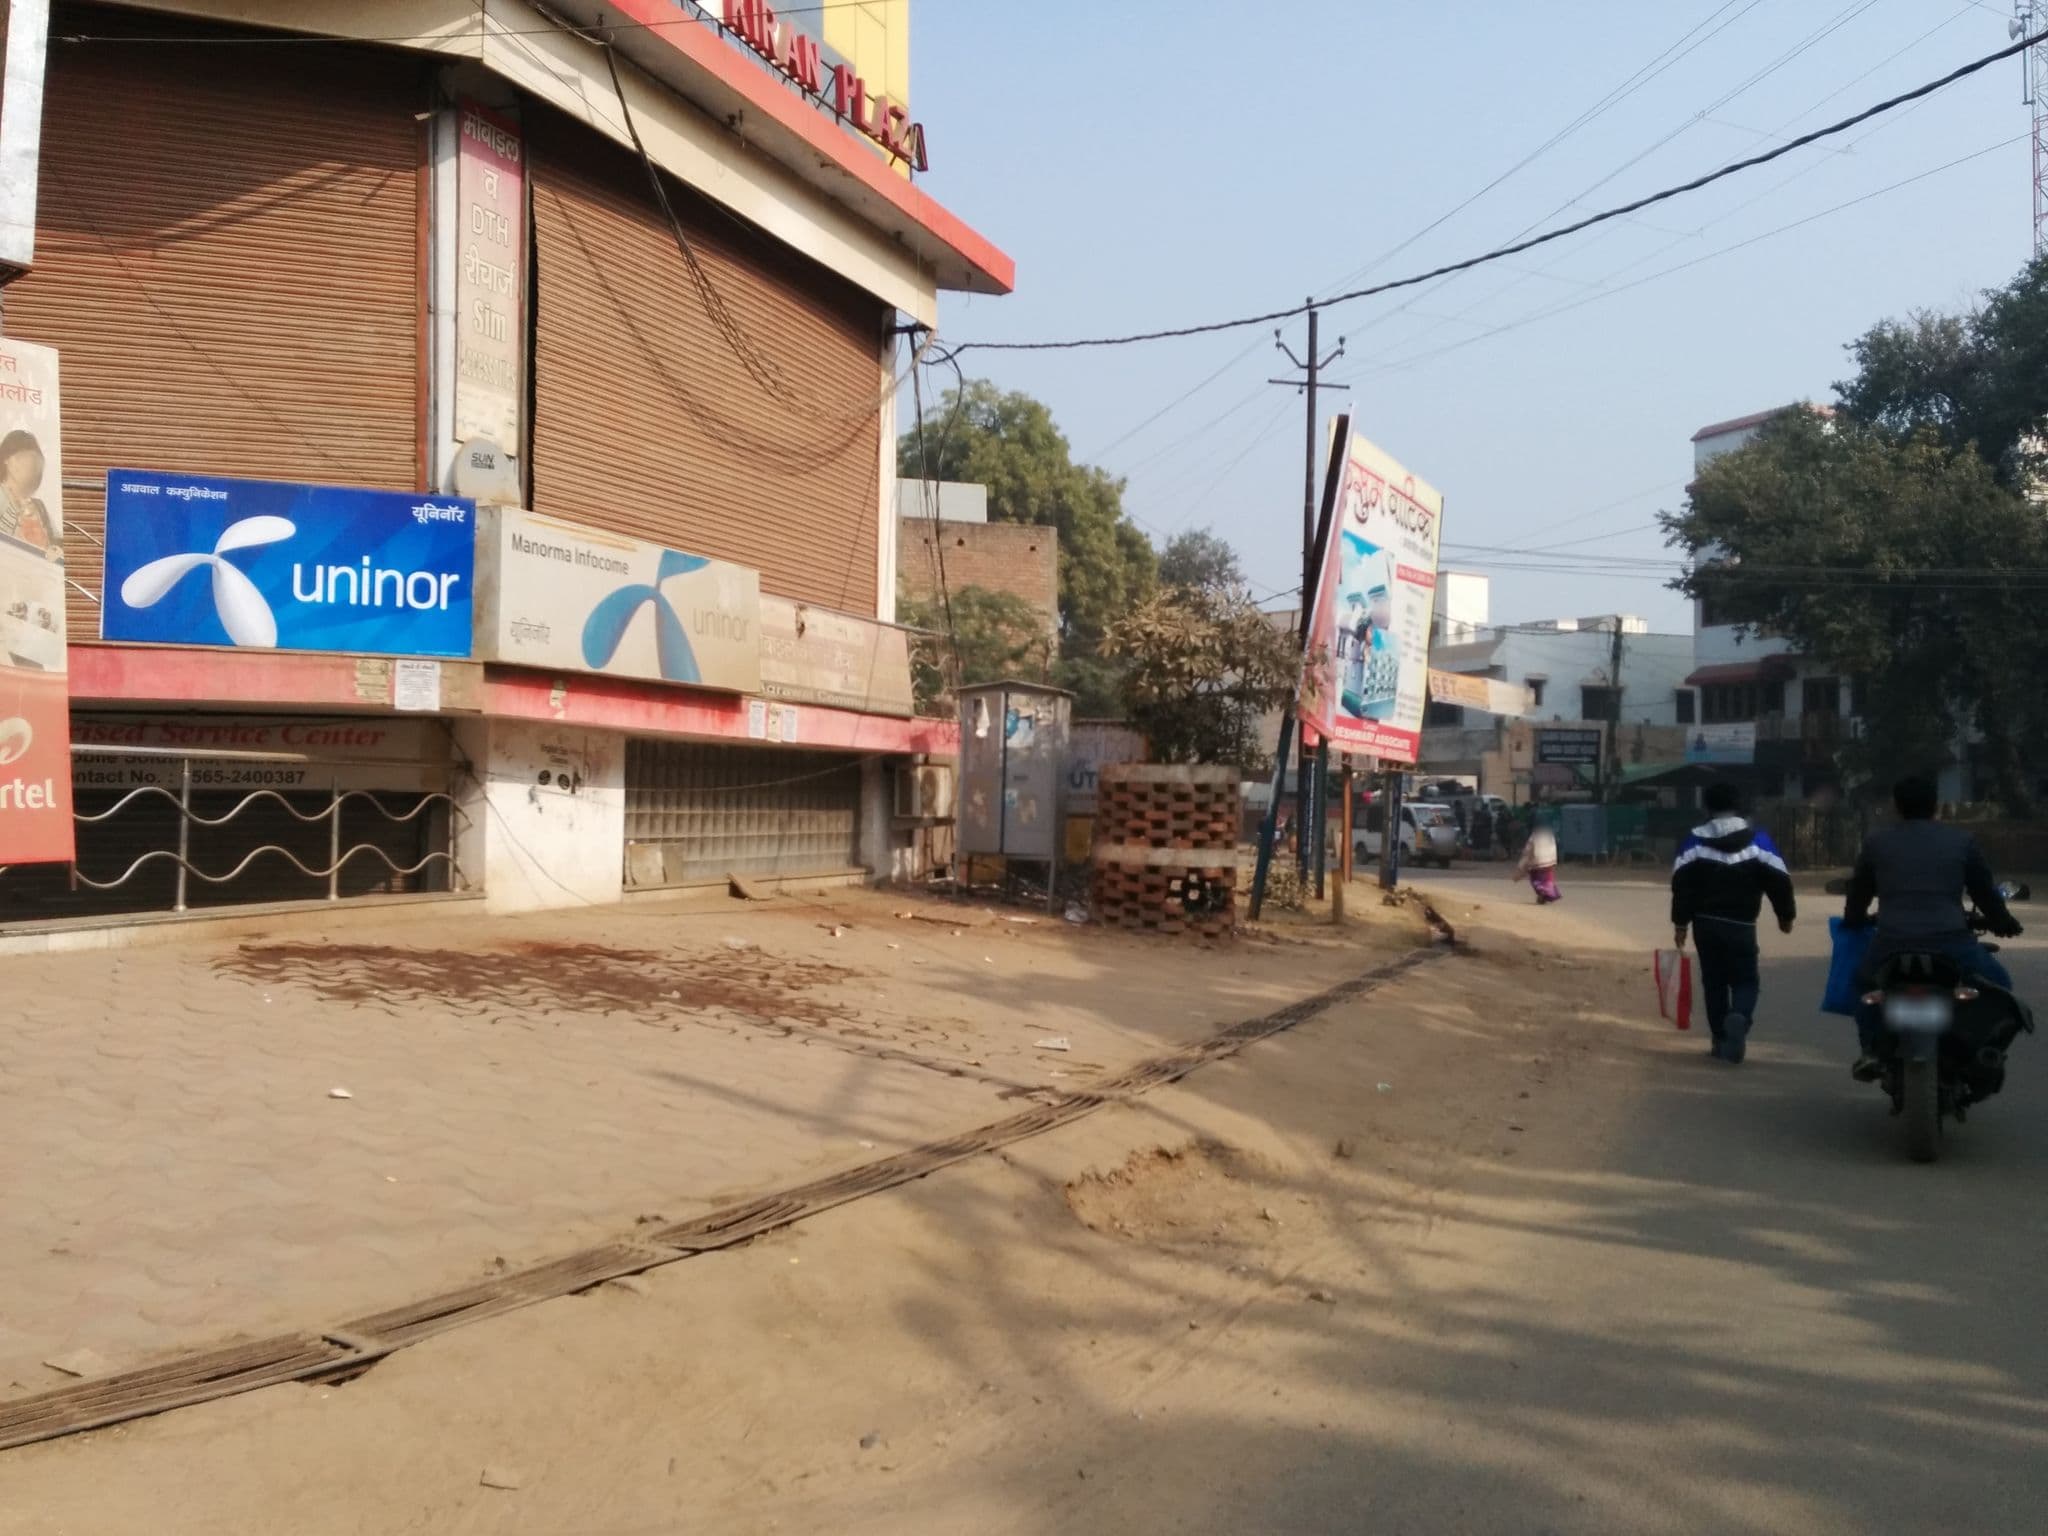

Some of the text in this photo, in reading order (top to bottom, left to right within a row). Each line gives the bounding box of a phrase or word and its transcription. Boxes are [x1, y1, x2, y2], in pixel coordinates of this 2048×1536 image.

[723, 0, 929, 172] KIRAN PLAZA
[463, 108, 520, 162] मोबाइल
[483, 169, 499, 200] व
[471, 204, 509, 248] DTH
[464, 245, 515, 299] रीचार्ज
[472, 298, 507, 342] Sim
[121, 483, 160, 495] अग्रवाल
[411, 503, 466, 524] यूनिनॉर
[511, 533, 630, 576] Manorma Infocome
[293, 555, 460, 610] uninor
[692, 604, 750, 642] uninor
[160, 721, 271, 745] Service
[281, 726, 385, 746] Center
[73, 770, 124, 784] ntact
[130, 770, 161, 784] No.
[182, 769, 305, 786] 565-2400387
